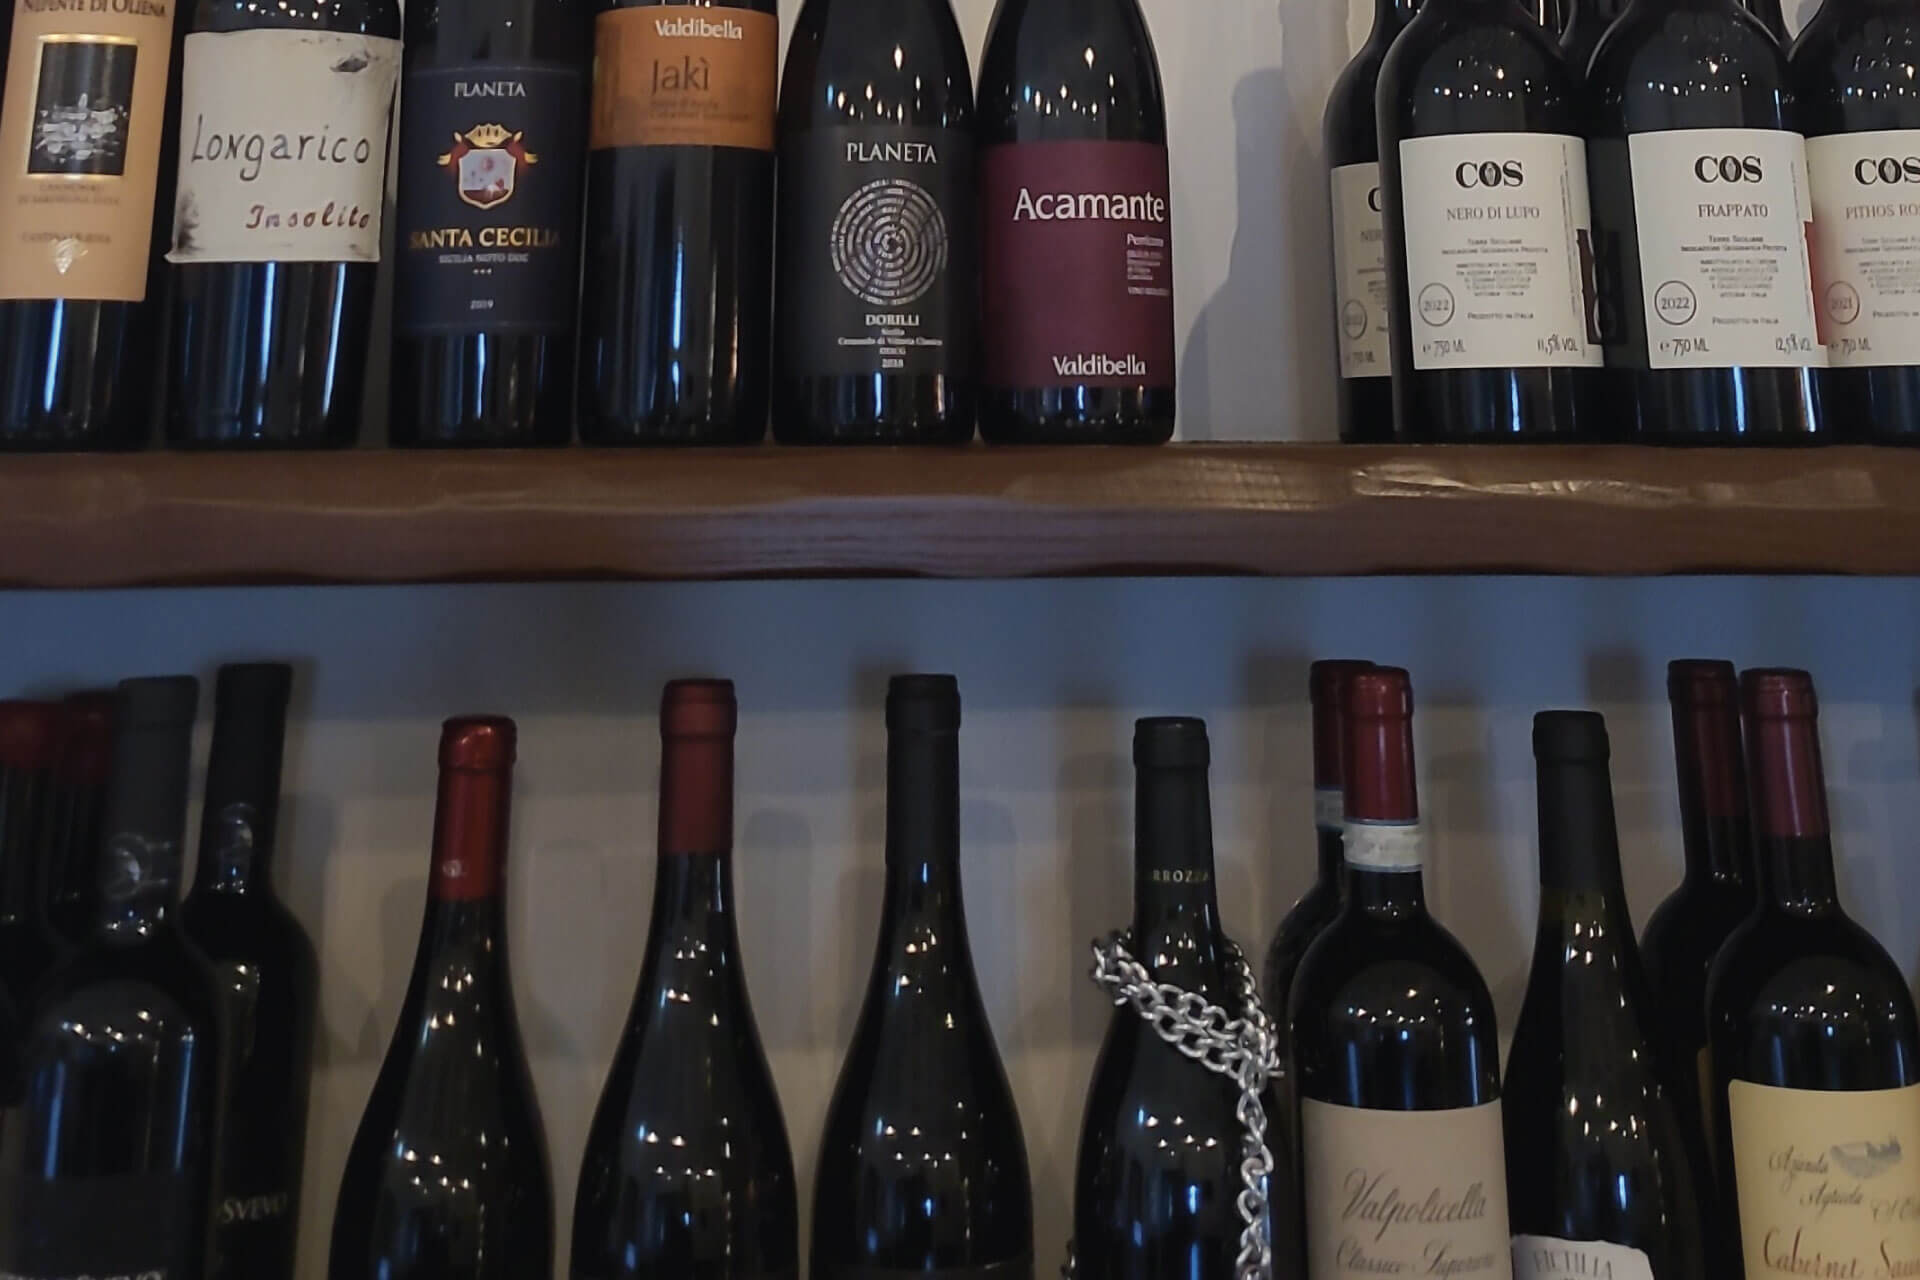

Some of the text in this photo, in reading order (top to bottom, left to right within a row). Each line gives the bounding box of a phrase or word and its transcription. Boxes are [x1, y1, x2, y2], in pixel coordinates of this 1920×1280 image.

[655, 17, 743, 40] Valdibella
[453, 81, 526, 97] PLANETA
[191, 113, 370, 181] Longarico
[847, 142, 937, 163] PLANETA
[1455, 160, 1524, 188] COS
[1694, 155, 1763, 183] COS
[1854, 157, 1920, 185] COS
[245, 201, 370, 229] Insolito
[1013, 188, 1165, 222] Acamante
[1446, 206, 1540, 221] NERO DI LUPO
[1698, 204, 1768, 218] FRAPPATO
[1845, 203, 1897, 220] PITHOS
[409, 227, 560, 248] SANTA CECILIA
[1660, 297, 1690, 310] 2022
[1672, 339, 1691, 356] 750
[1052, 354, 1146, 376] Valdibella
[1342, 1167, 1487, 1243] Valpolicella
